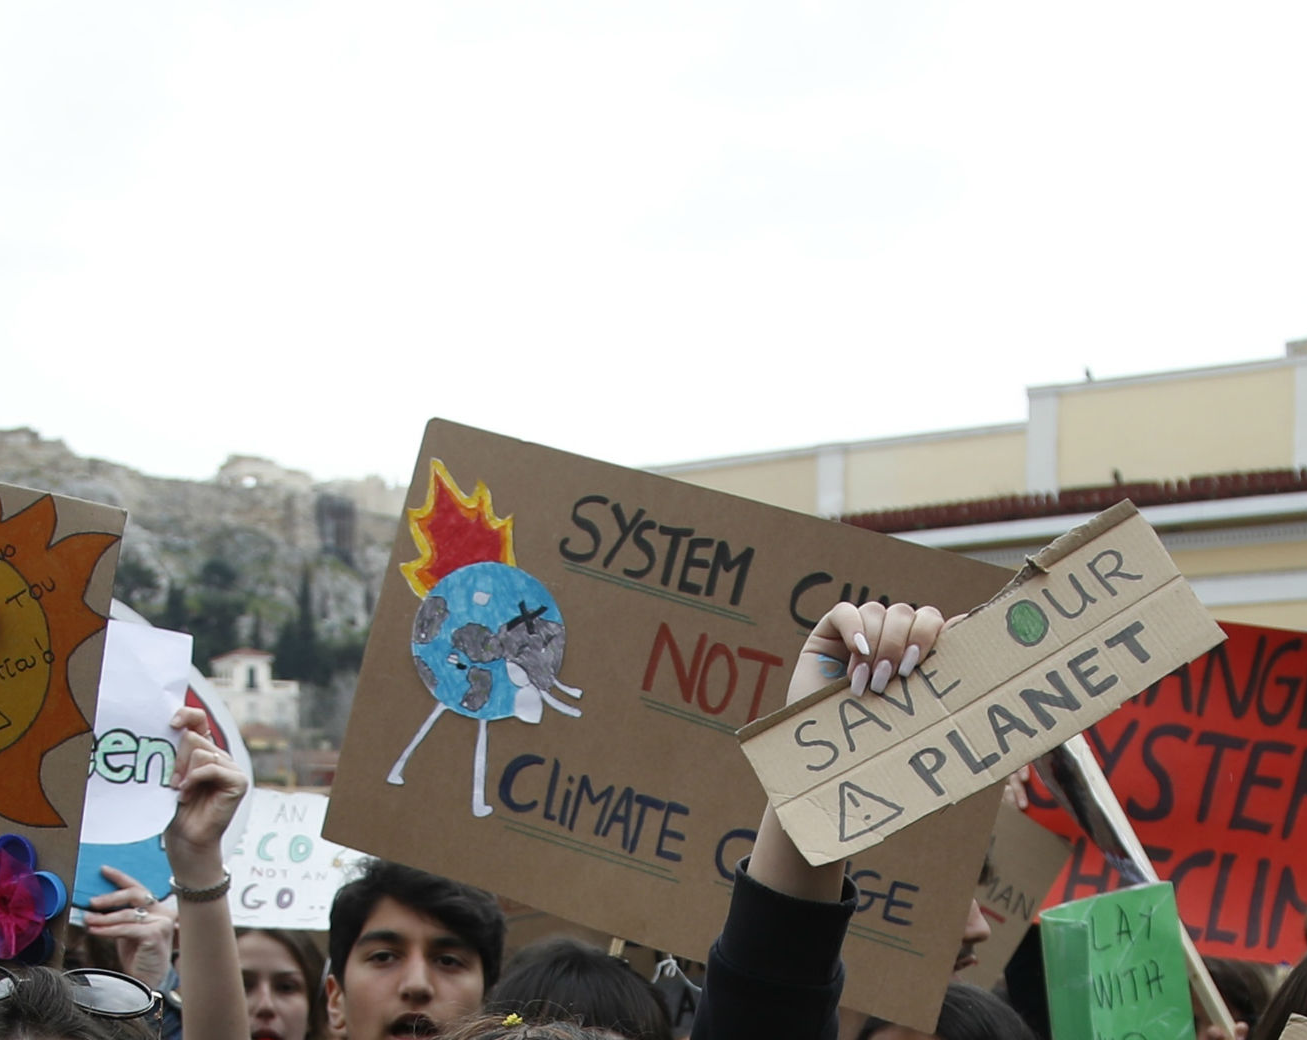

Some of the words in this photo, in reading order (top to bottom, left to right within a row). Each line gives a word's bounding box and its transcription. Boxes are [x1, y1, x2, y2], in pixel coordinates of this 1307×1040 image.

[559, 494, 755, 607] SYSTEM
[640, 622, 784, 728] NOT
[794, 651, 962, 773] SAVE
[1005, 547, 1144, 648] OUR
[907, 621, 1155, 797] PLANET
[88, 728, 178, 788] en
[273, 803, 308, 824] AN
[249, 864, 290, 879] NOT
[301, 871, 328, 881] AN
[256, 832, 314, 863] CO
[240, 883, 295, 910] GO
[1093, 960, 1165, 1010] WITH
